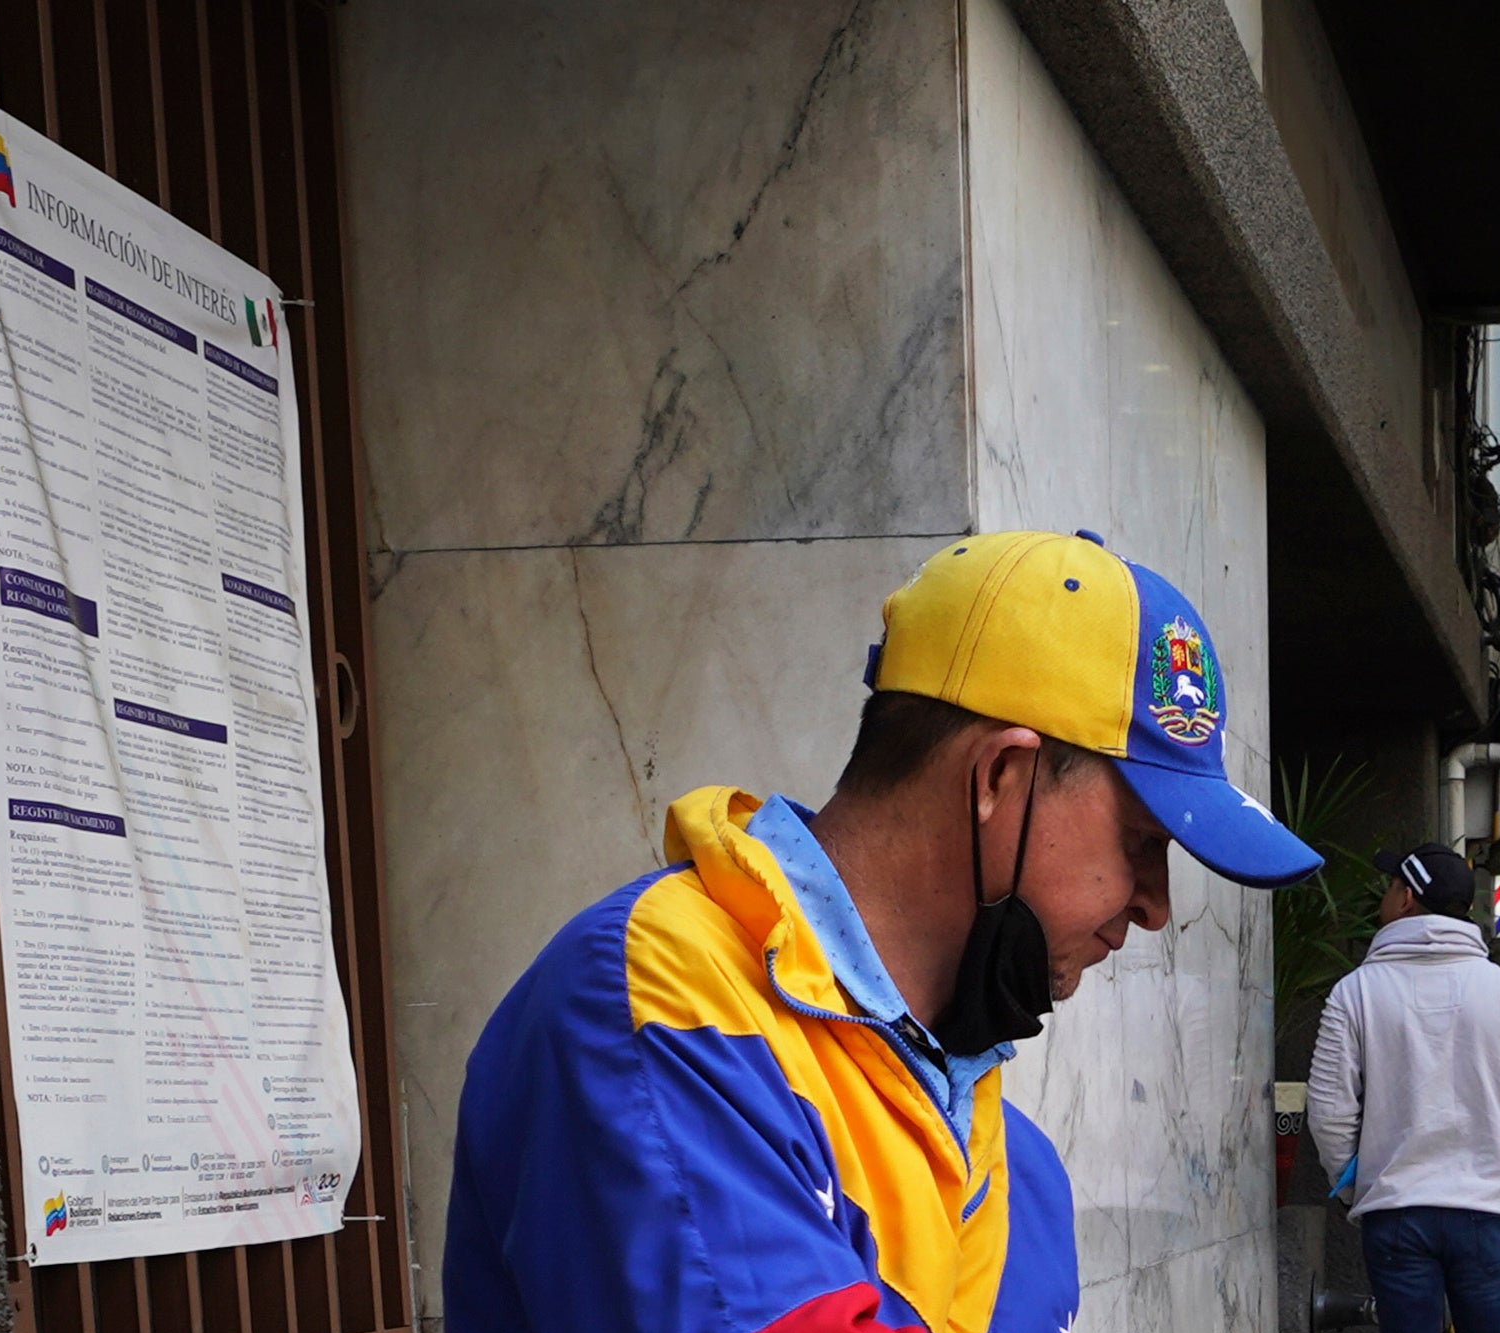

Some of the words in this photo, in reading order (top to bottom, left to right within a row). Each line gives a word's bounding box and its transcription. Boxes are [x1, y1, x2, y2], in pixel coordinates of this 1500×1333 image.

[26, 180, 148, 274] INFORMACIÓN
[151, 254, 173, 290] DE
[176, 269, 237, 326] INTERÉS
